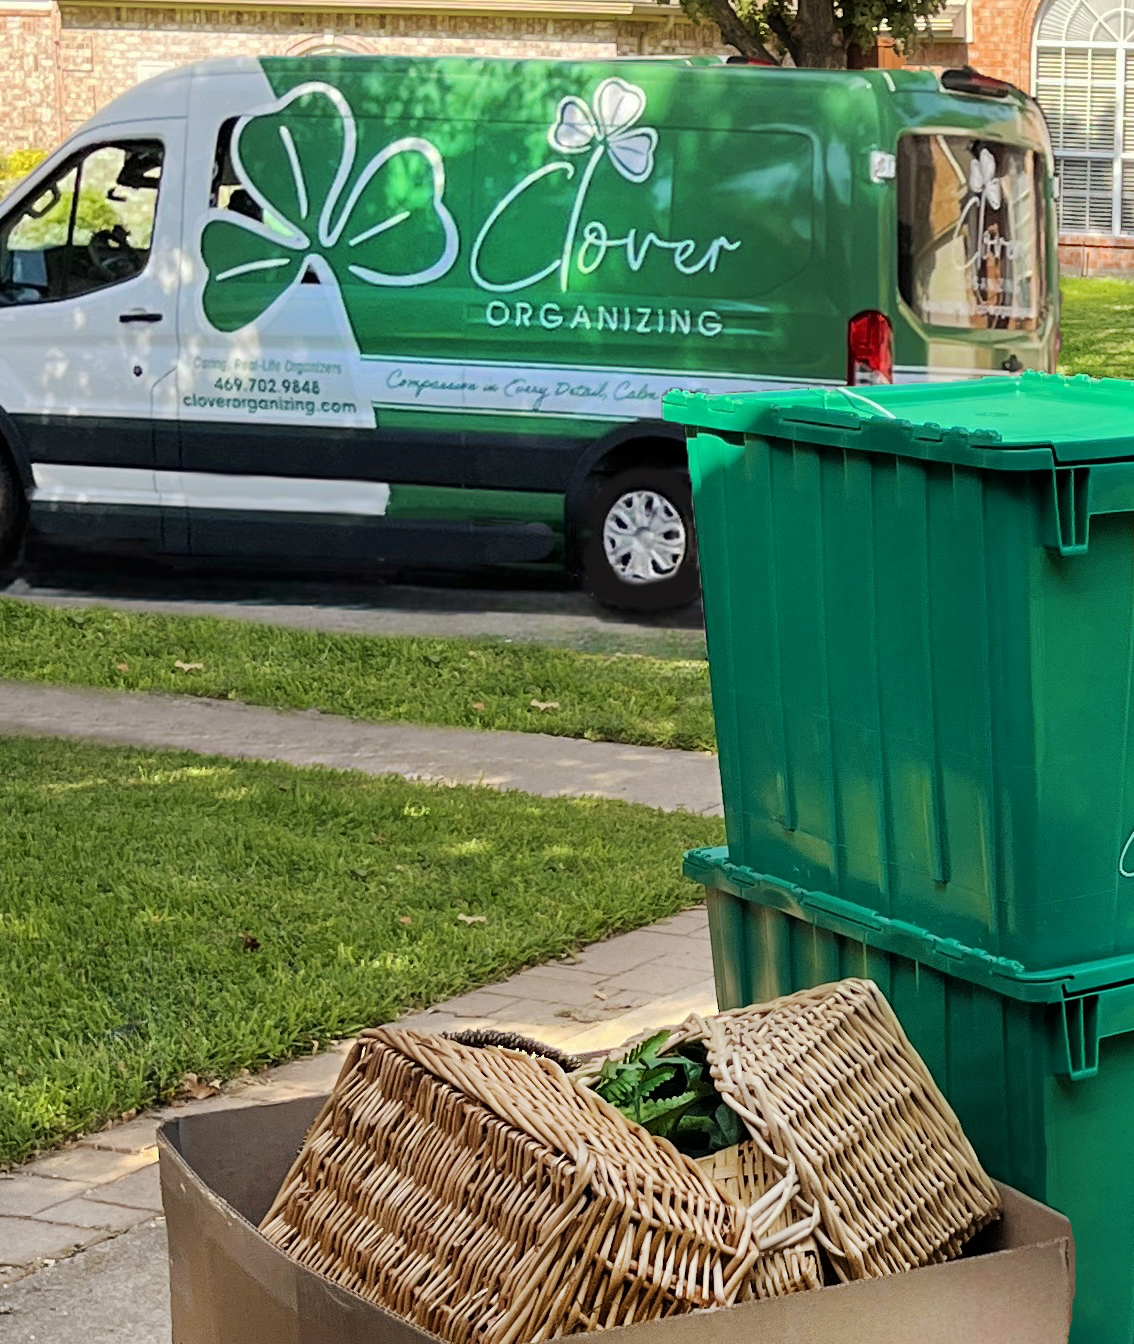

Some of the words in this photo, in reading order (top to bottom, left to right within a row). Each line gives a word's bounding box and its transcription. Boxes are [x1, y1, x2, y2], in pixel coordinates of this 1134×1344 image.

[470, 144, 742, 293] Clover
[485, 300, 723, 336] ORGANIZING
[213, 377, 321, 395] 469.702.9848
[183, 394, 357, 415] cloverorganizing.com
